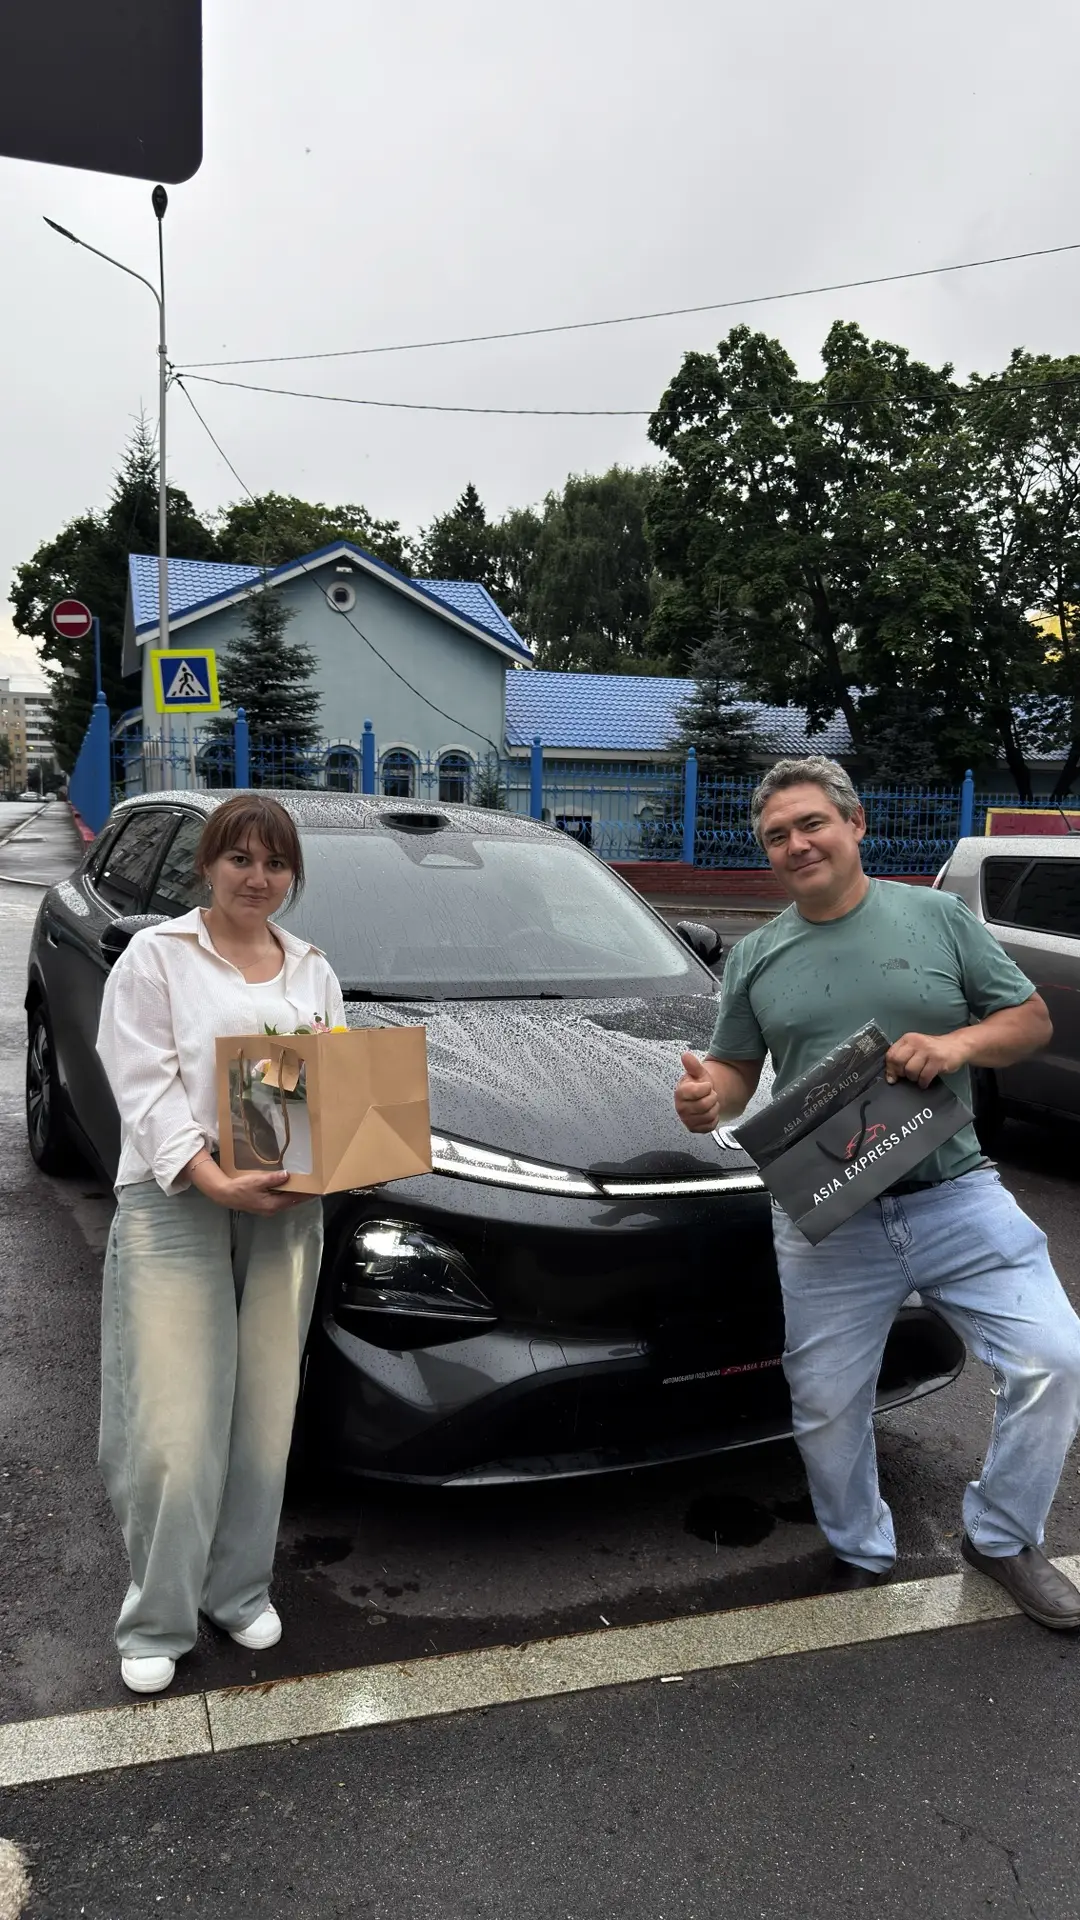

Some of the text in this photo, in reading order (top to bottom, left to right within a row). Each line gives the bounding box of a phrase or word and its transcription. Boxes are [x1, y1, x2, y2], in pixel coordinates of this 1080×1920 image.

[783, 1071, 859, 1134] ASIA EXPRESS AUTO
[812, 1108, 933, 1206] ASIA EXPRESS AUTO
[742, 1363, 757, 1371] ASIA
